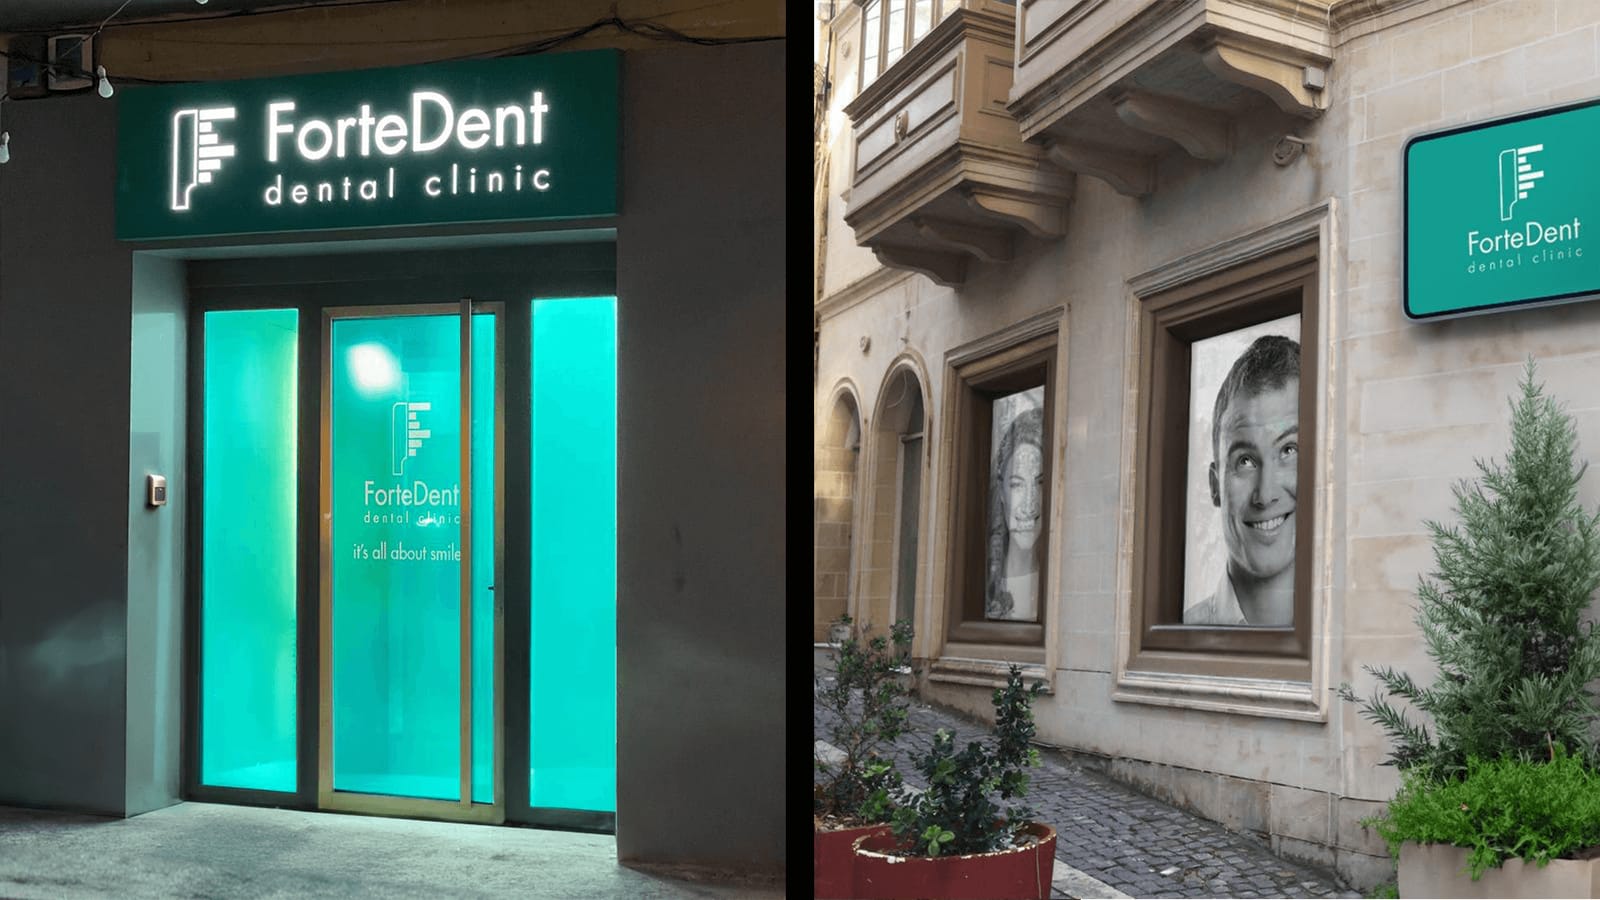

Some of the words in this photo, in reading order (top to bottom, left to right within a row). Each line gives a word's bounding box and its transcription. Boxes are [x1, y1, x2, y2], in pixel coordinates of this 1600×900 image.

[267, 90, 549, 162] ForteDent
[264, 167, 395, 206] dental
[425, 163, 551, 197] clinic
[1468, 217, 1581, 256] ForteDent
[1467, 253, 1522, 274] dental
[1532, 247, 1583, 264] clinic
[364, 480, 460, 506] ForteDent
[363, 510, 409, 524] dental
[417, 510, 460, 525] clinic
[353, 543, 369, 560] it's
[372, 541, 387, 560] all
[390, 541, 427, 561] about
[430, 542, 461, 561] smile
